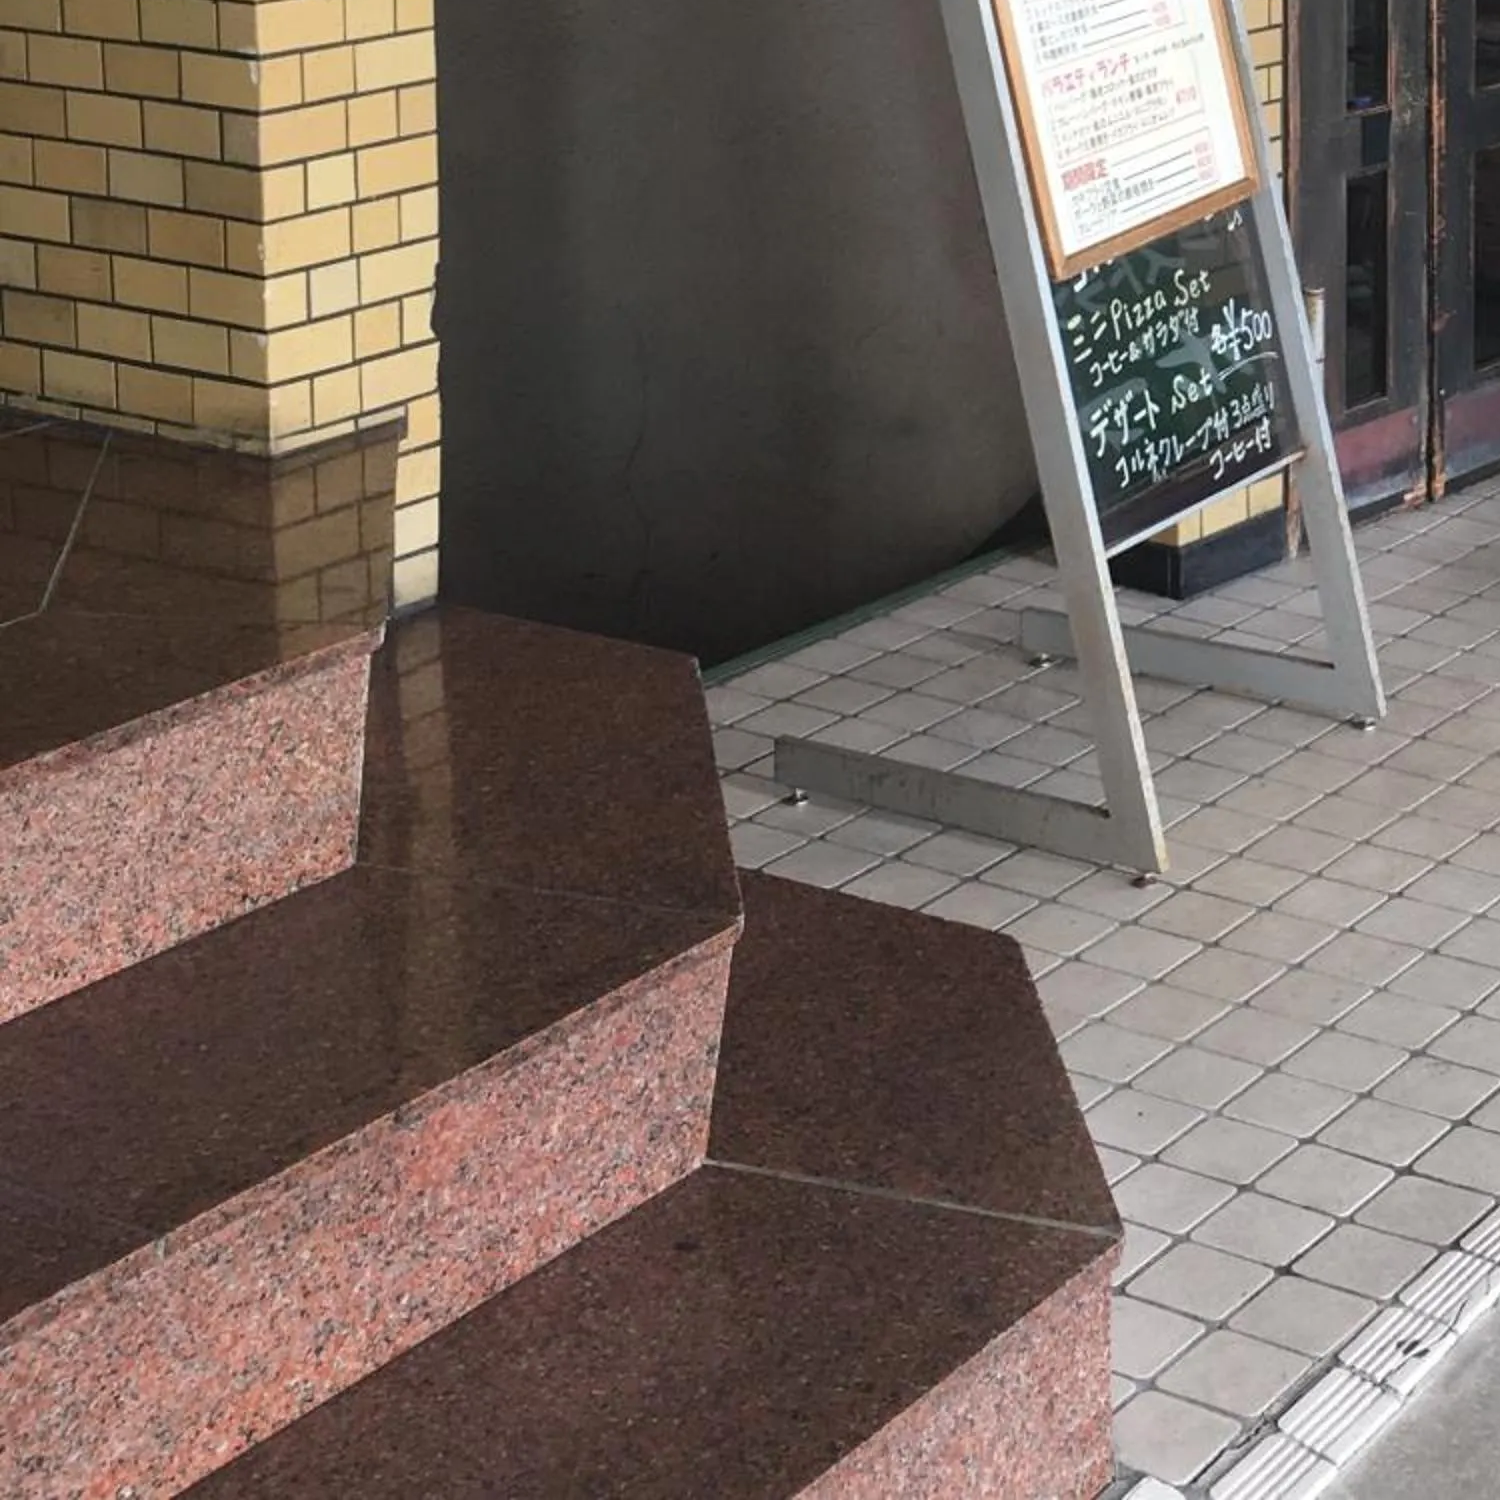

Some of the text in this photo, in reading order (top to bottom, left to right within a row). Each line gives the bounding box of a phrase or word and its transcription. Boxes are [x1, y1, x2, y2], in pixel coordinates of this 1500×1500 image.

[1173, 268, 1211, 306] Set
[1089, 367, 1213, 458] デザート Set
[1209, 415, 1272, 481] コーヒー付
